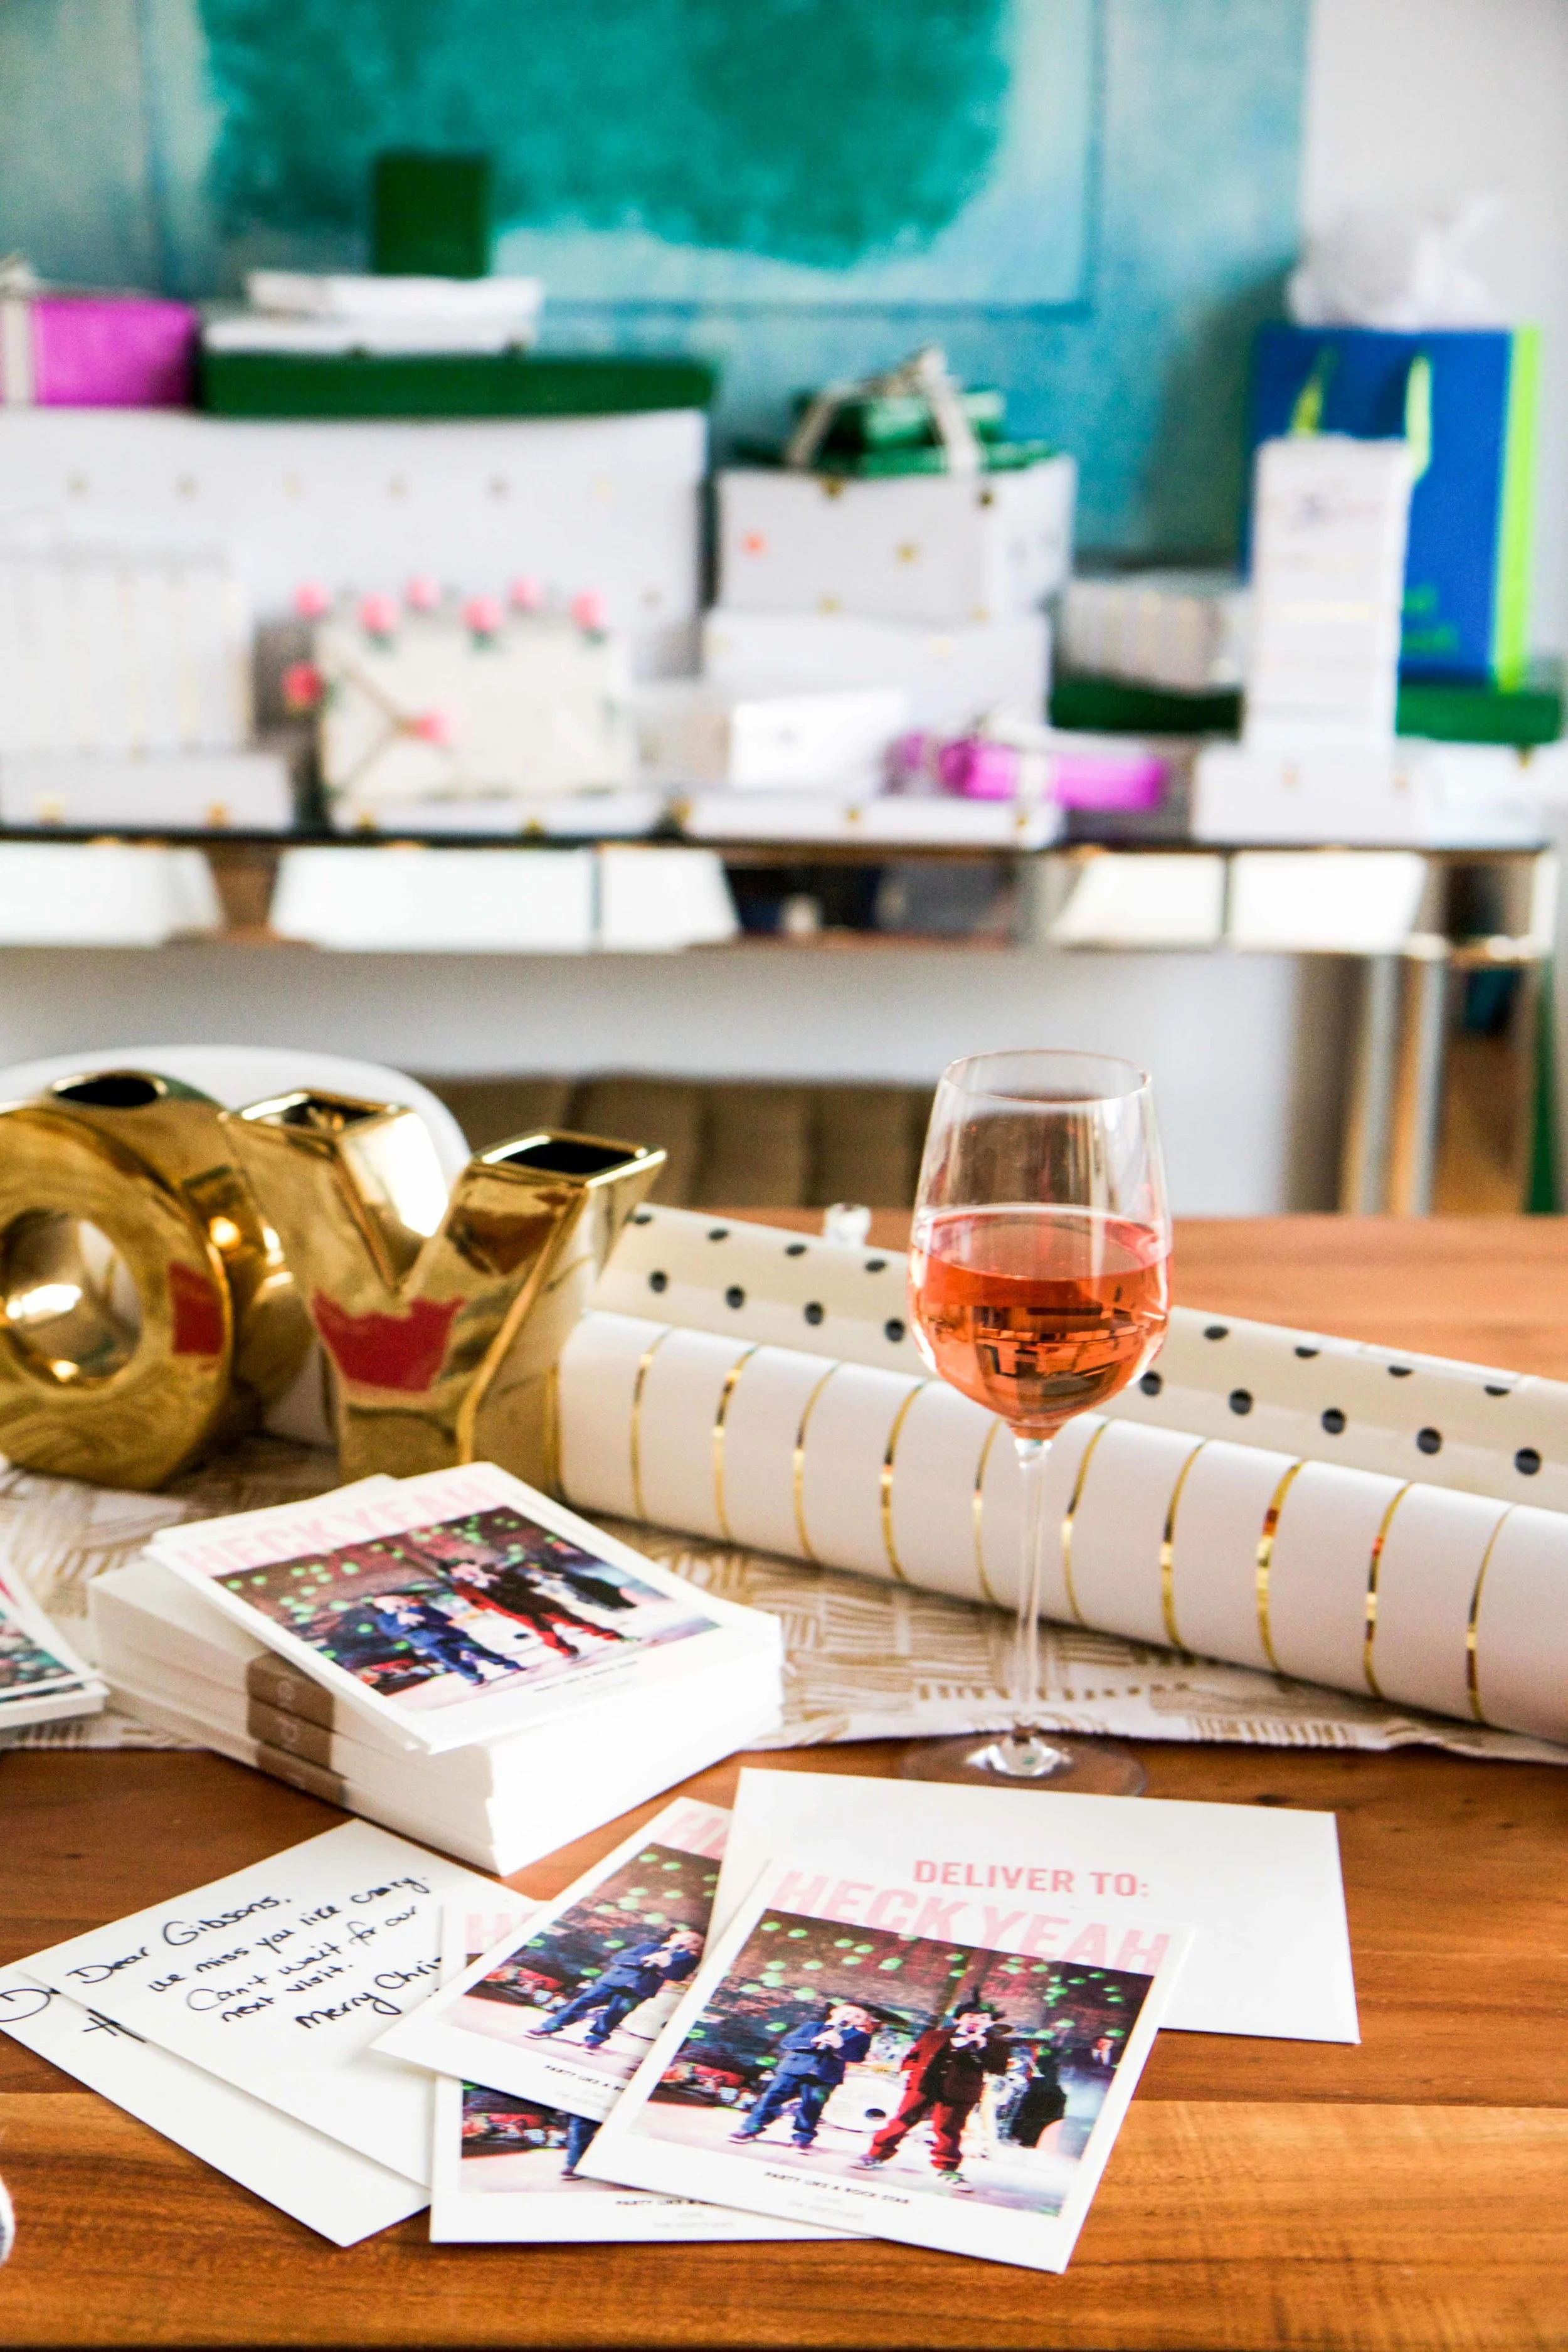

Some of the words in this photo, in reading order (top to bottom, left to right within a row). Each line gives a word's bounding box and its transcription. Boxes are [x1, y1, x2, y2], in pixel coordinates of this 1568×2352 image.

[176, 1514, 331, 1576] HECK
[913, 1860, 1074, 1894] DELIVER
[1089, 1871, 1150, 1897] TO:
[194, 1947, 250, 1973] miss
[256, 1929, 296, 1954] you
[300, 1905, 342, 1926] like
[278, 1942, 342, 1976] wait
[346, 1920, 377, 1947] for
[385, 1905, 418, 1927] our
[768, 1870, 969, 1939] HECK
[970, 1905, 1173, 1976] YEAH
[65, 1946, 150, 1984] Dear
[221, 1996, 275, 2023] next
[285, 1963, 355, 1992] visit.
[295, 1991, 402, 2030] Merry
